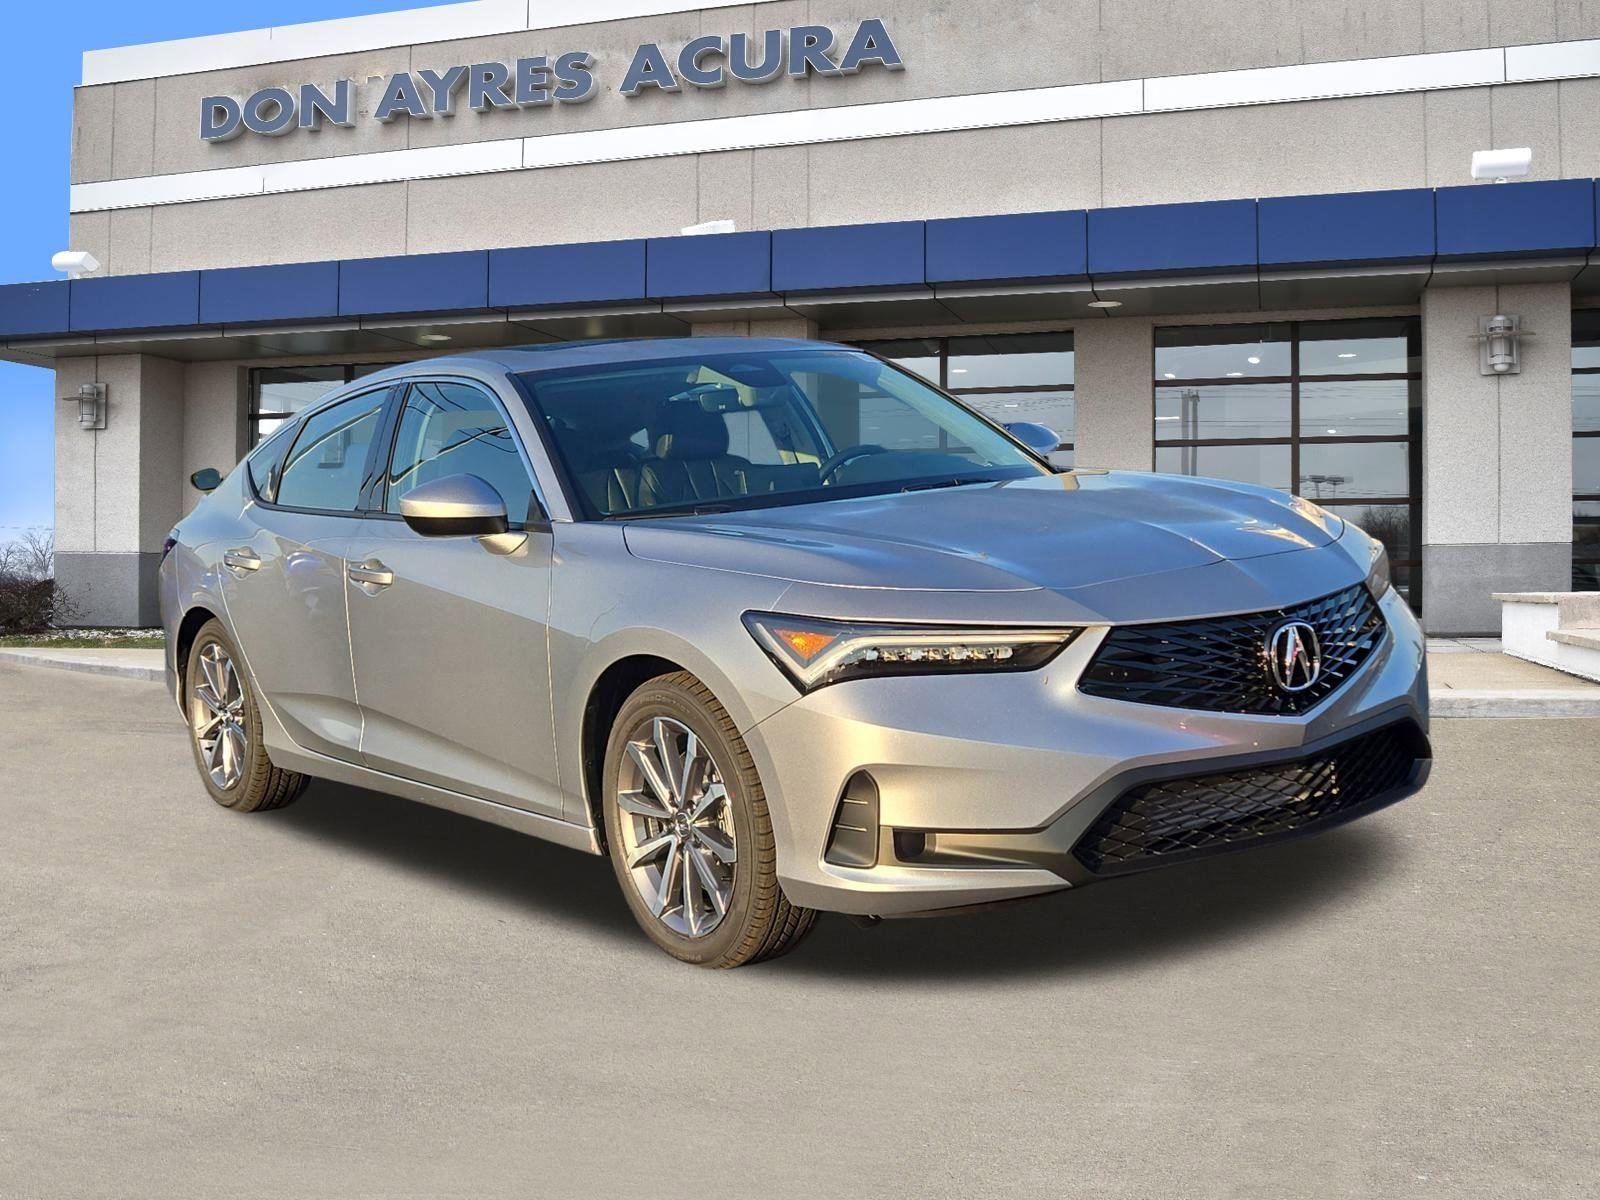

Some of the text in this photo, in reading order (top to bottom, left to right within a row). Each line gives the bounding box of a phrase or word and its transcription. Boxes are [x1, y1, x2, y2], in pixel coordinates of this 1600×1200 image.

[199, 17, 905, 142] DON AYRES ACURA
